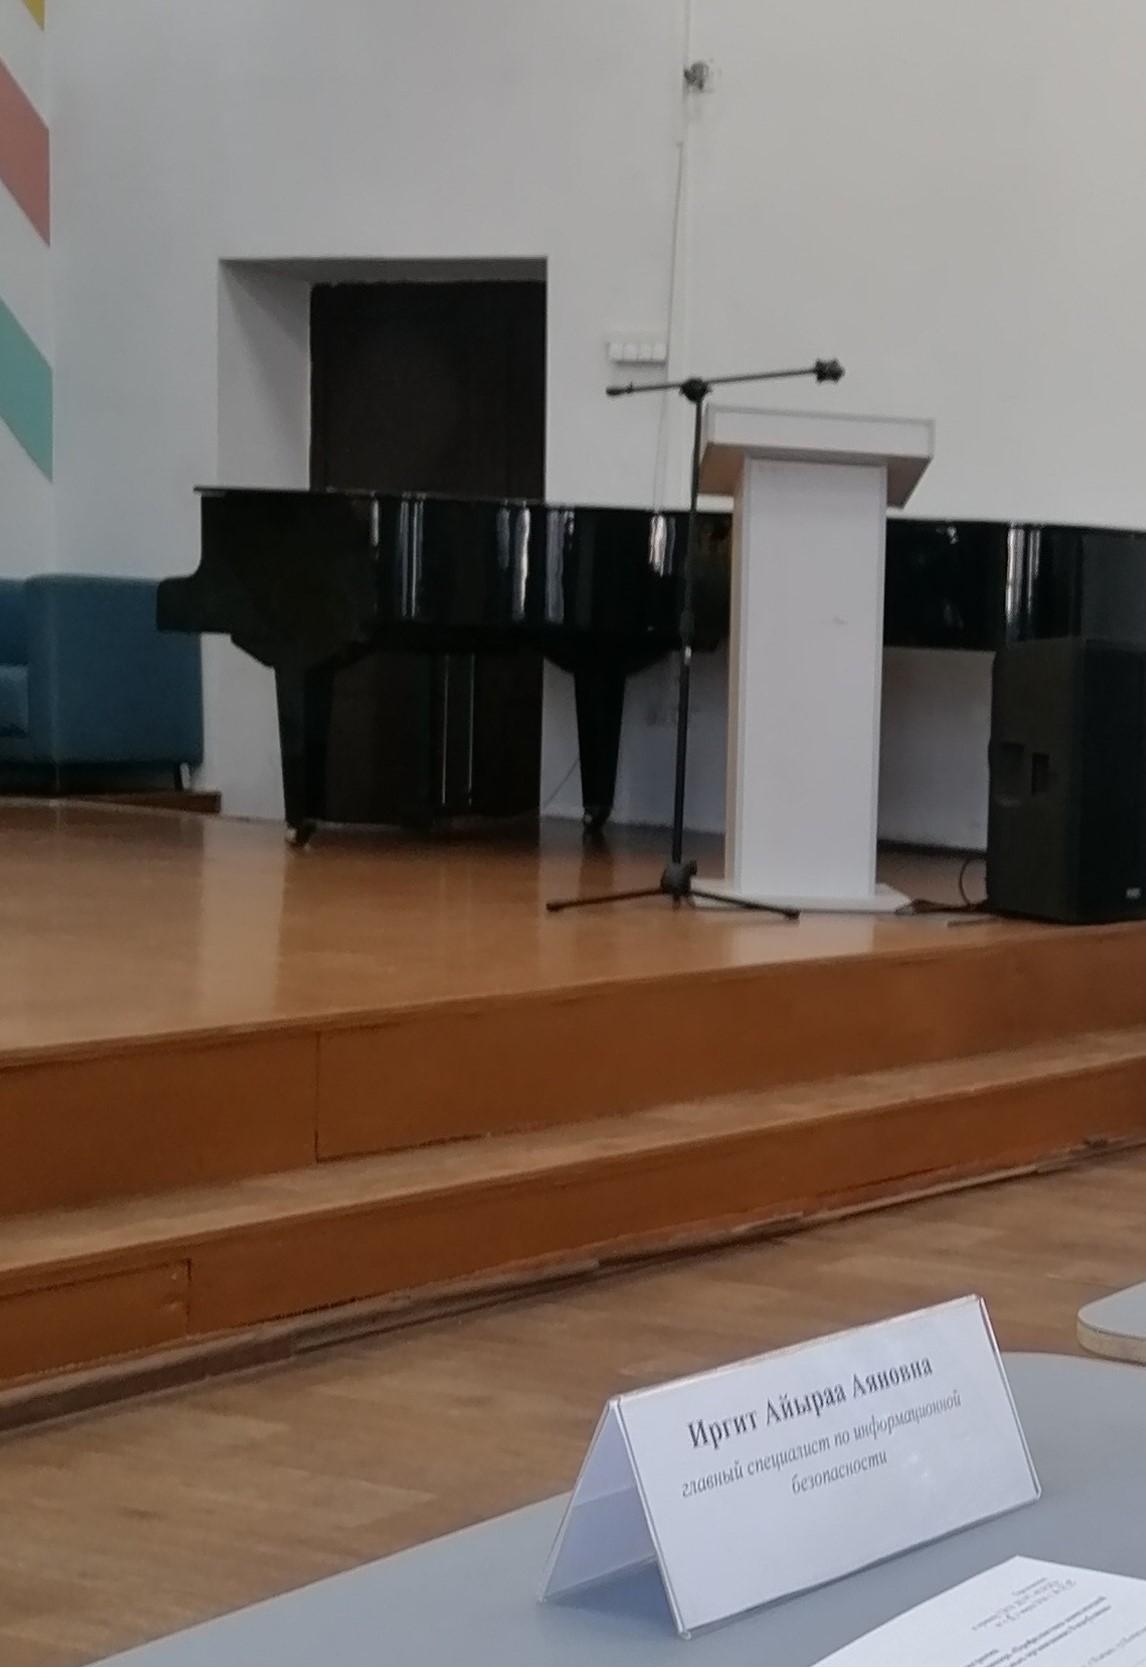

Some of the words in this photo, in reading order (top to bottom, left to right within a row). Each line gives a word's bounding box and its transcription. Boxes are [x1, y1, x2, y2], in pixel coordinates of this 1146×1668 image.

[682, 1460, 743, 1498] главный
[747, 1436, 831, 1476] специалист
[834, 1430, 850, 1450] по
[854, 1390, 962, 1441] информационной
[687, 1410, 758, 1450] Иргит
[765, 1384, 847, 1426] Айыраа
[852, 1357, 934, 1399] Аяновна
[791, 1450, 888, 1494] безопасности
